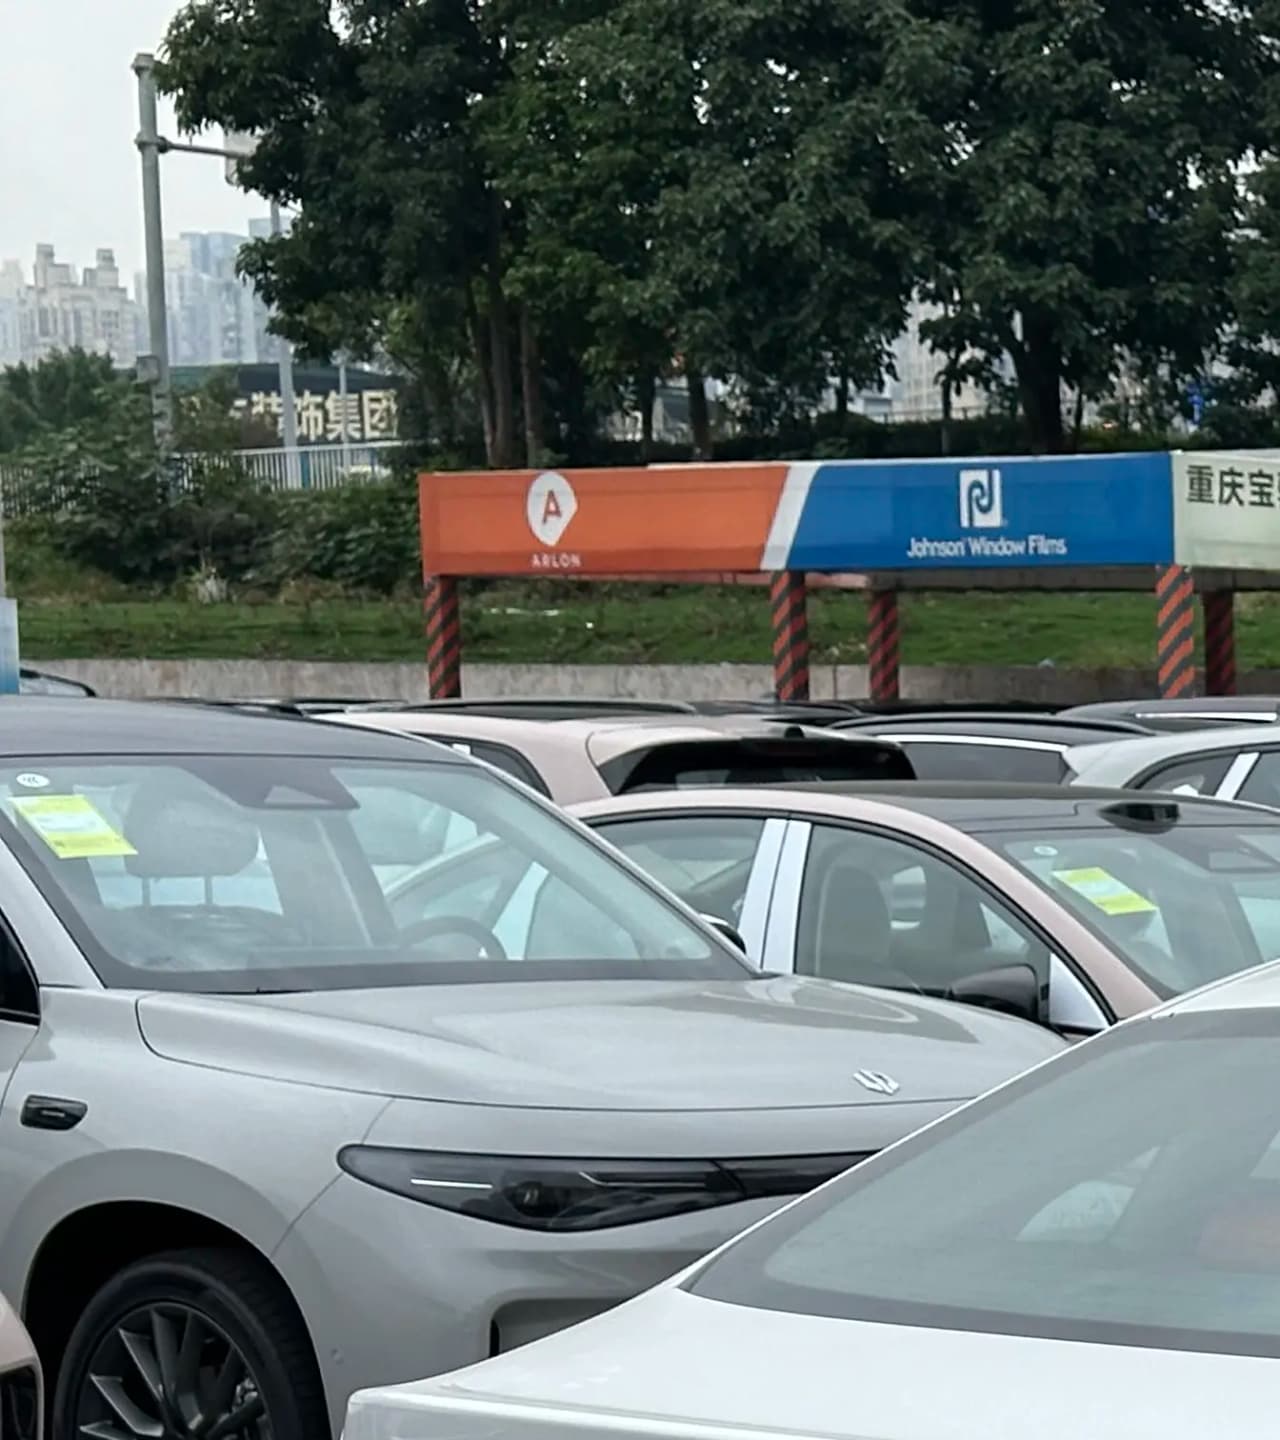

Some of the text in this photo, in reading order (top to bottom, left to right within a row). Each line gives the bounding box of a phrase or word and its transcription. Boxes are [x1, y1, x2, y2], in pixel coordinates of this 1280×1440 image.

[907, 533, 1067, 559] Johnson Window Films
[531, 553, 581, 569] ARLON
